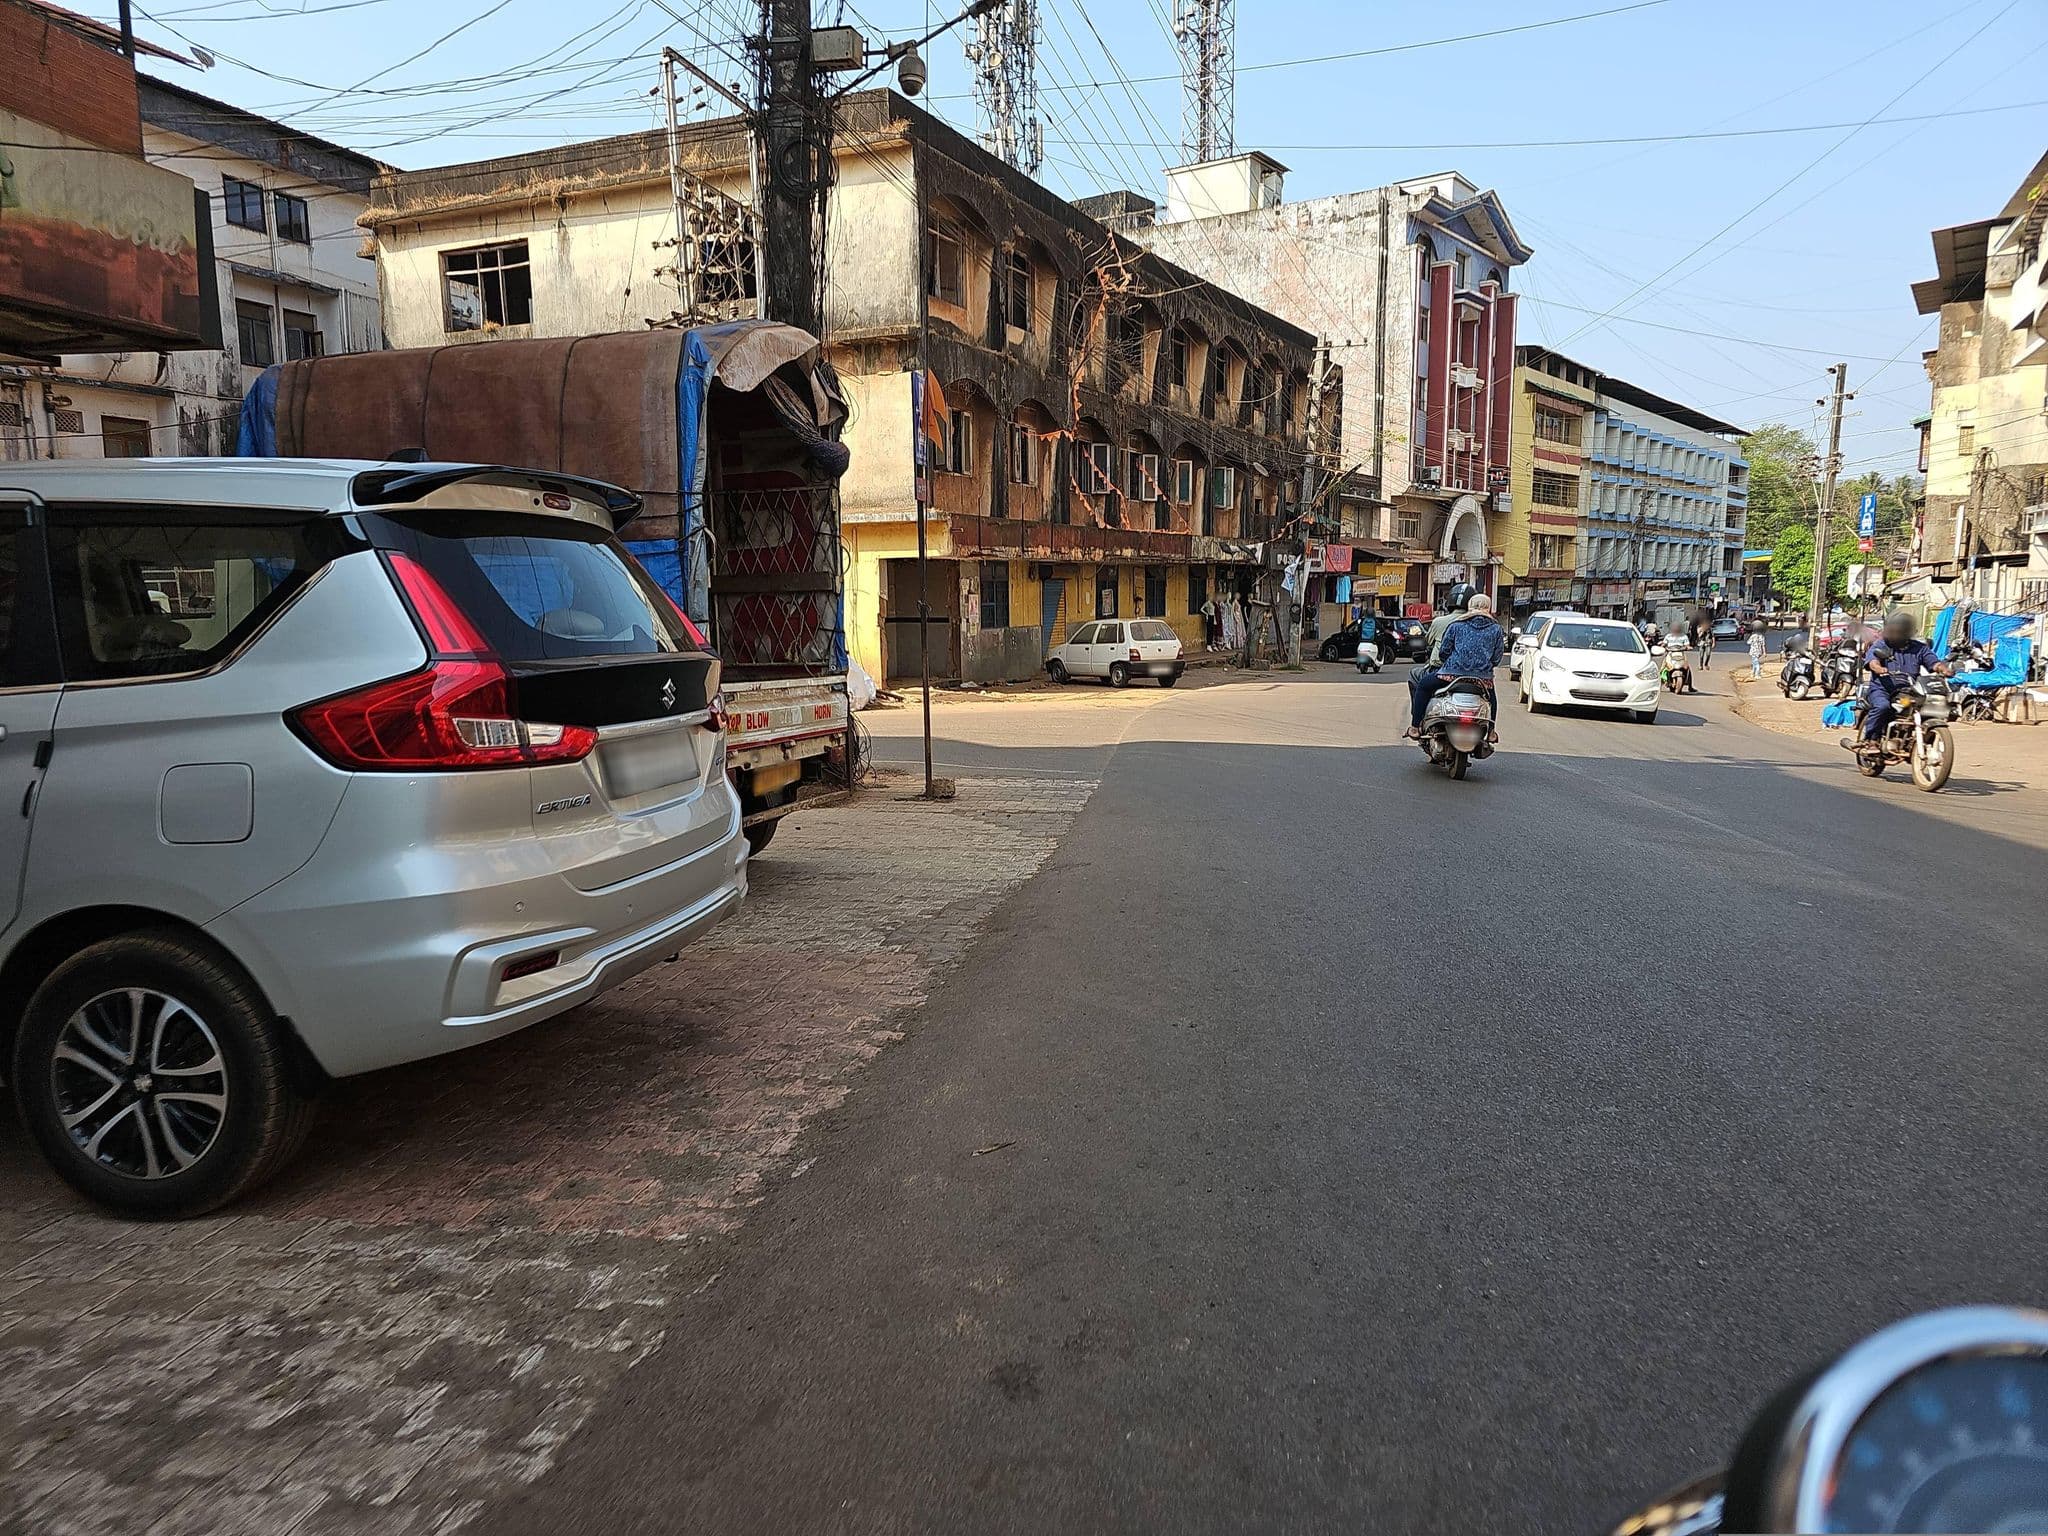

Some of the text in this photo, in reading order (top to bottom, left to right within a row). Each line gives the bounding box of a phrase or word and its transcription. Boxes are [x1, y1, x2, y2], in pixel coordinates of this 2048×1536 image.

[1380, 571, 1403, 587] realme
[746, 711, 769, 730] BLOW
[815, 704, 831, 720] HORN
[536, 793, 591, 814] ERTIGA
